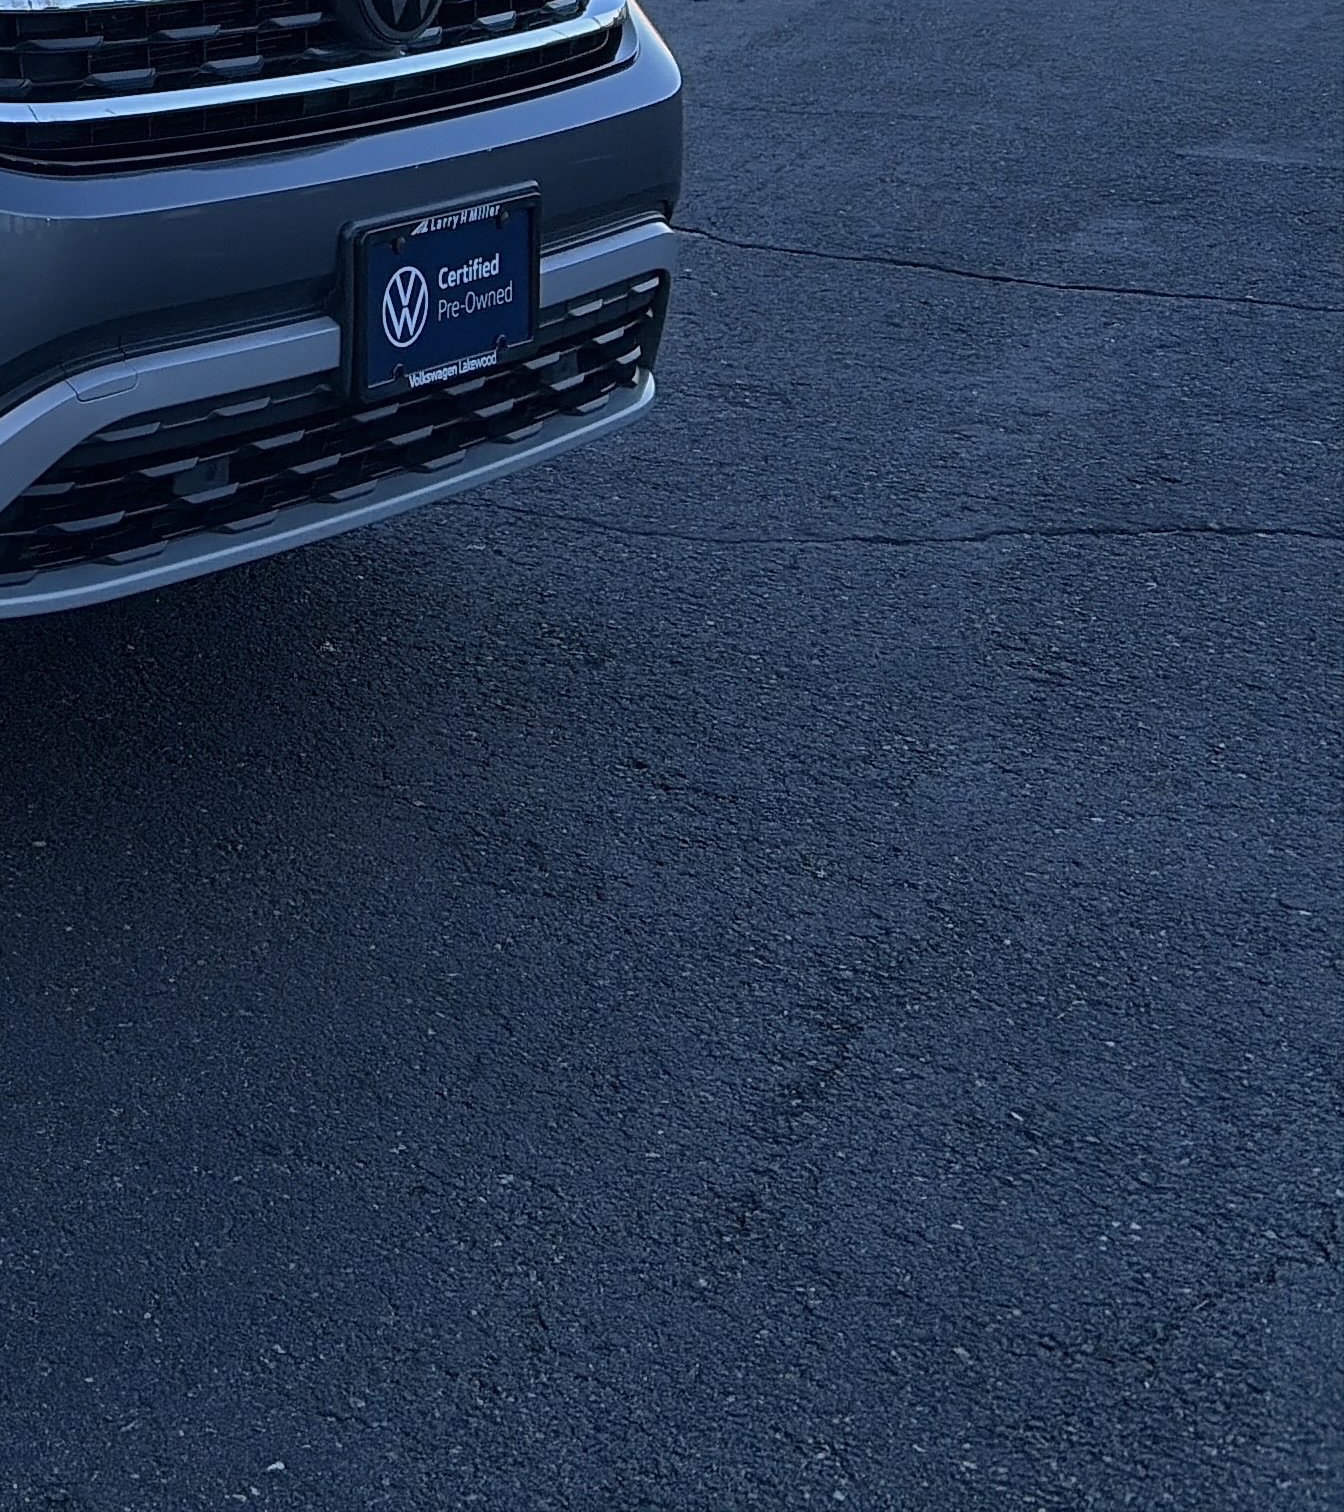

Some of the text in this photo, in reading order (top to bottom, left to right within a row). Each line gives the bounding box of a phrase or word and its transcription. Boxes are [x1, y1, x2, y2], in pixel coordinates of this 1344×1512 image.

[430, 204, 501, 231] Larry H Miller
[438, 252, 500, 289] Certified
[382, 266, 429, 348] VW
[437, 280, 513, 322] Pre-Owned
[408, 349, 498, 389] Volkswagen Lakewood
